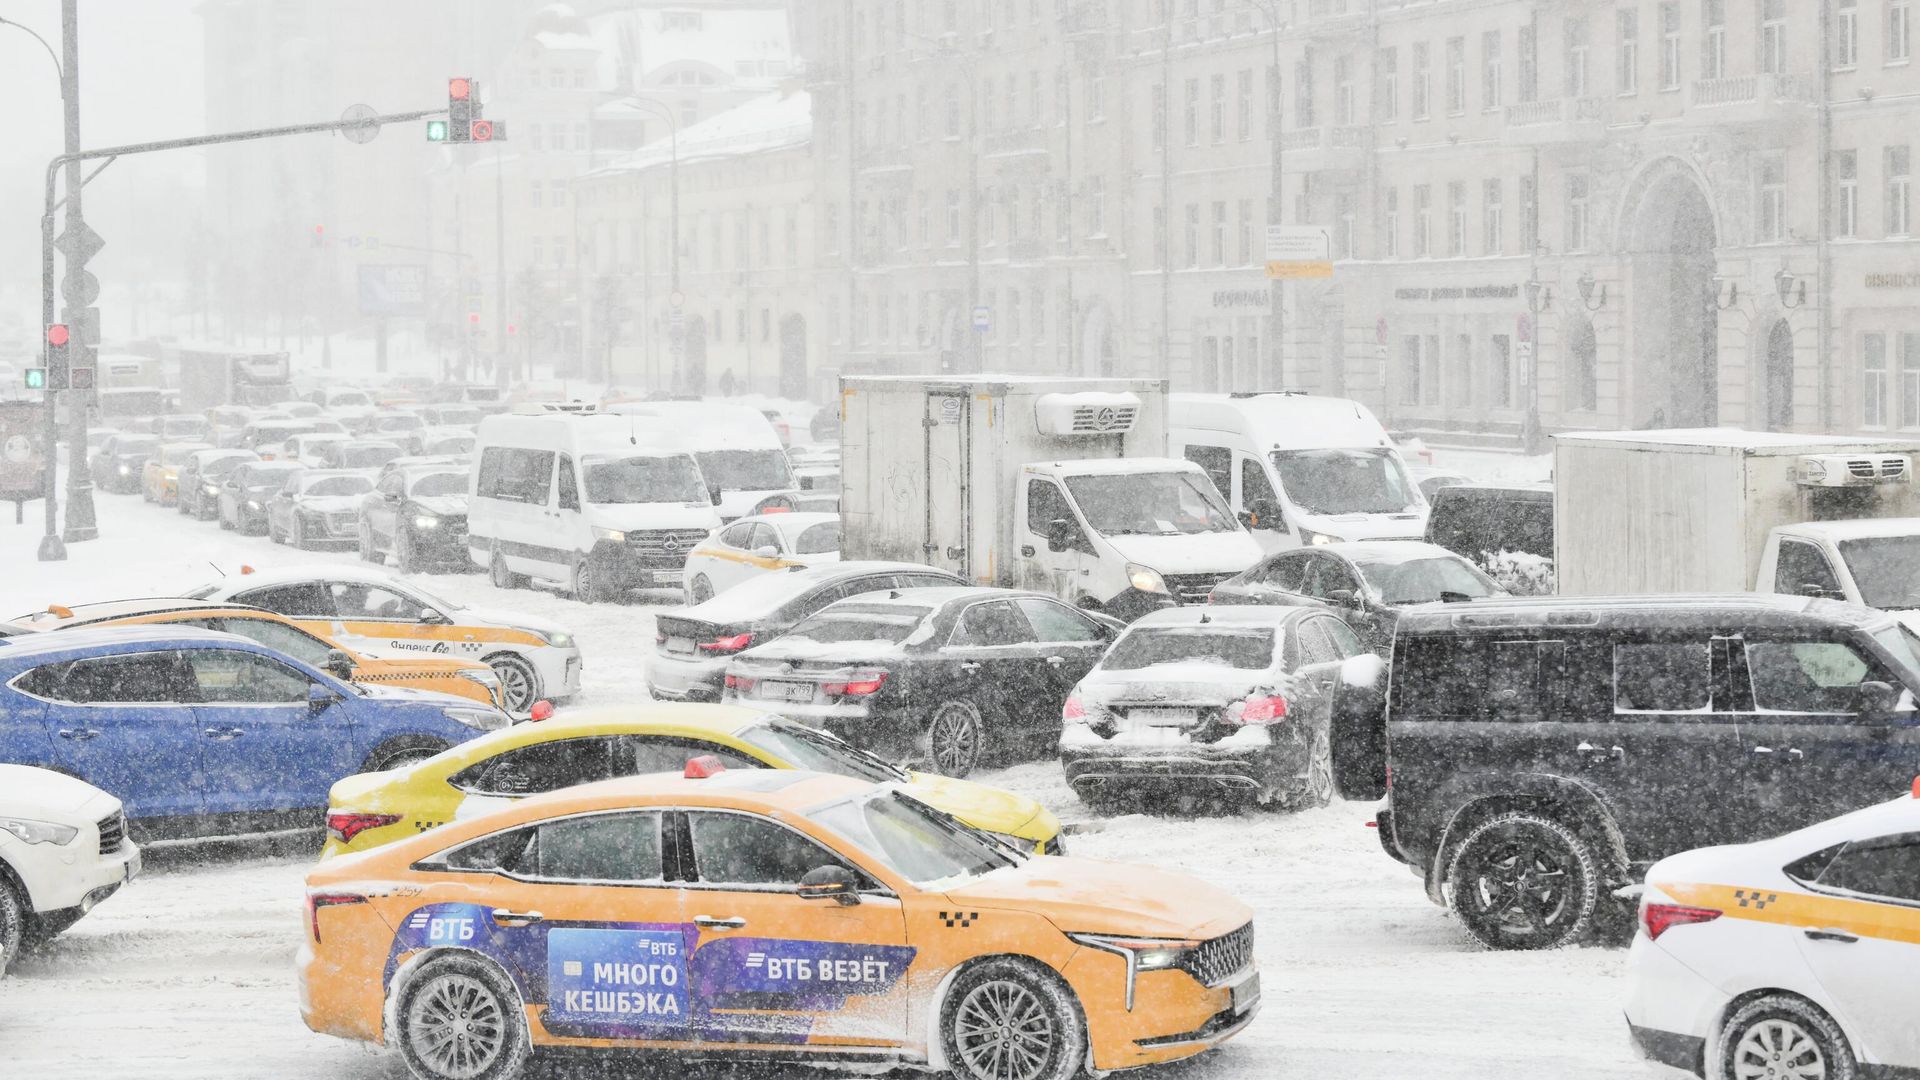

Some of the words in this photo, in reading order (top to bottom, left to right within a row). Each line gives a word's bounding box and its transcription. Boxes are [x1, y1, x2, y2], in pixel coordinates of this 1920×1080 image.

[430, 918, 474, 941] ВТБ
[651, 942, 677, 956] ВТБ
[593, 962, 678, 986] МНОГО
[768, 957, 812, 981] ВТБ
[818, 955, 889, 983] ВЕЗЁТ
[565, 990, 680, 1015] КЕШБЭКА
